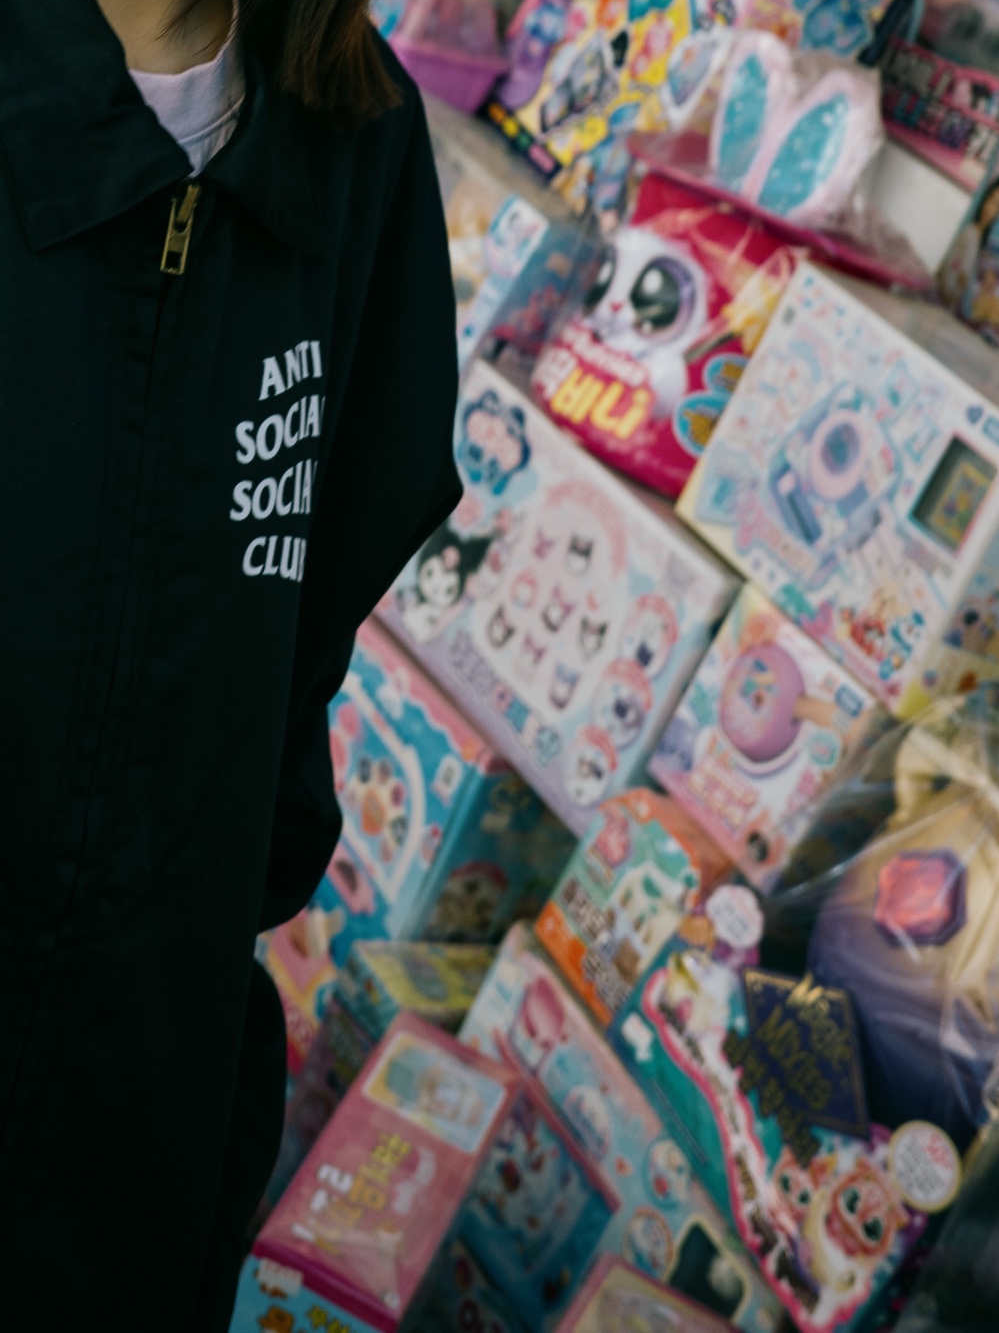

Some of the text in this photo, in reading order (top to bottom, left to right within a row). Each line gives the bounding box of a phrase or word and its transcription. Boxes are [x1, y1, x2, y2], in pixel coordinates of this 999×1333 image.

[258, 340, 322, 401] ANTI
[235, 394, 326, 464] SOCIA
[229, 459, 318, 521] SOCIA
